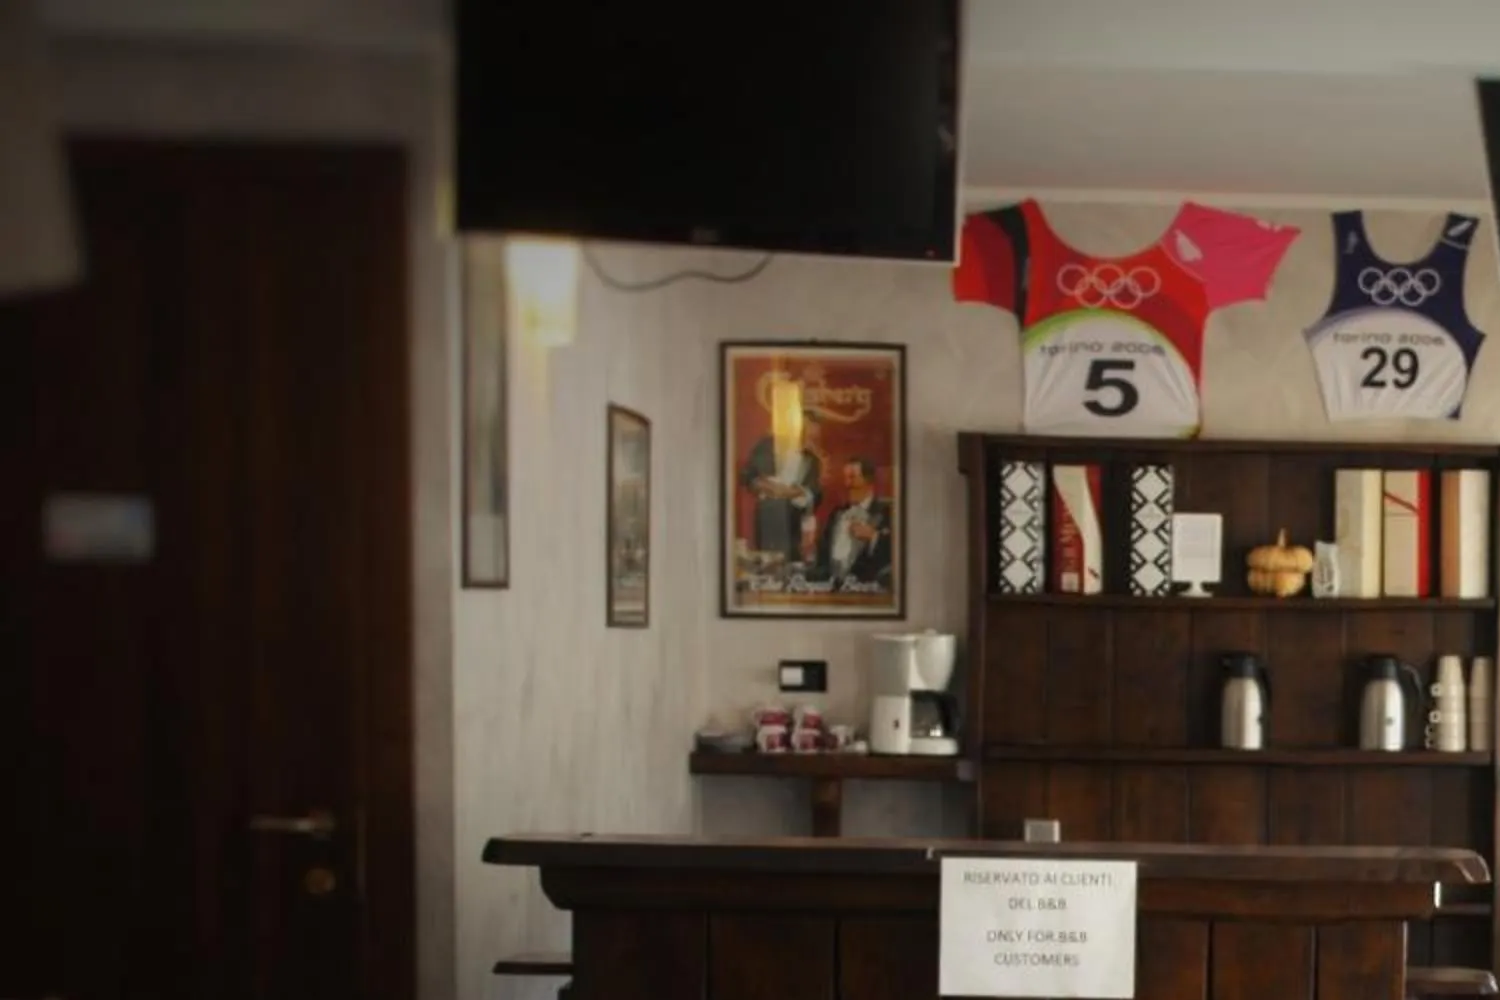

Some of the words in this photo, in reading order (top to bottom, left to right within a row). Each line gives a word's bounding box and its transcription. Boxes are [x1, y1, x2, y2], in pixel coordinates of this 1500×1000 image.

[1360, 345, 1420, 391] 29
[1081, 358, 1140, 418] 5
[962, 871, 1040, 886] RISERVATO
[1043, 872, 1058, 886] AI
[1061, 872, 1113, 887] CLIENTI
[1007, 898, 1033, 911] DEL
[1037, 898, 1067, 911] B&B
[986, 930, 1024, 943] ONLY
[1027, 930, 1054, 944] FOR
[1057, 931, 1088, 945] B&B
[993, 953, 1081, 968] CUSTOMERS
